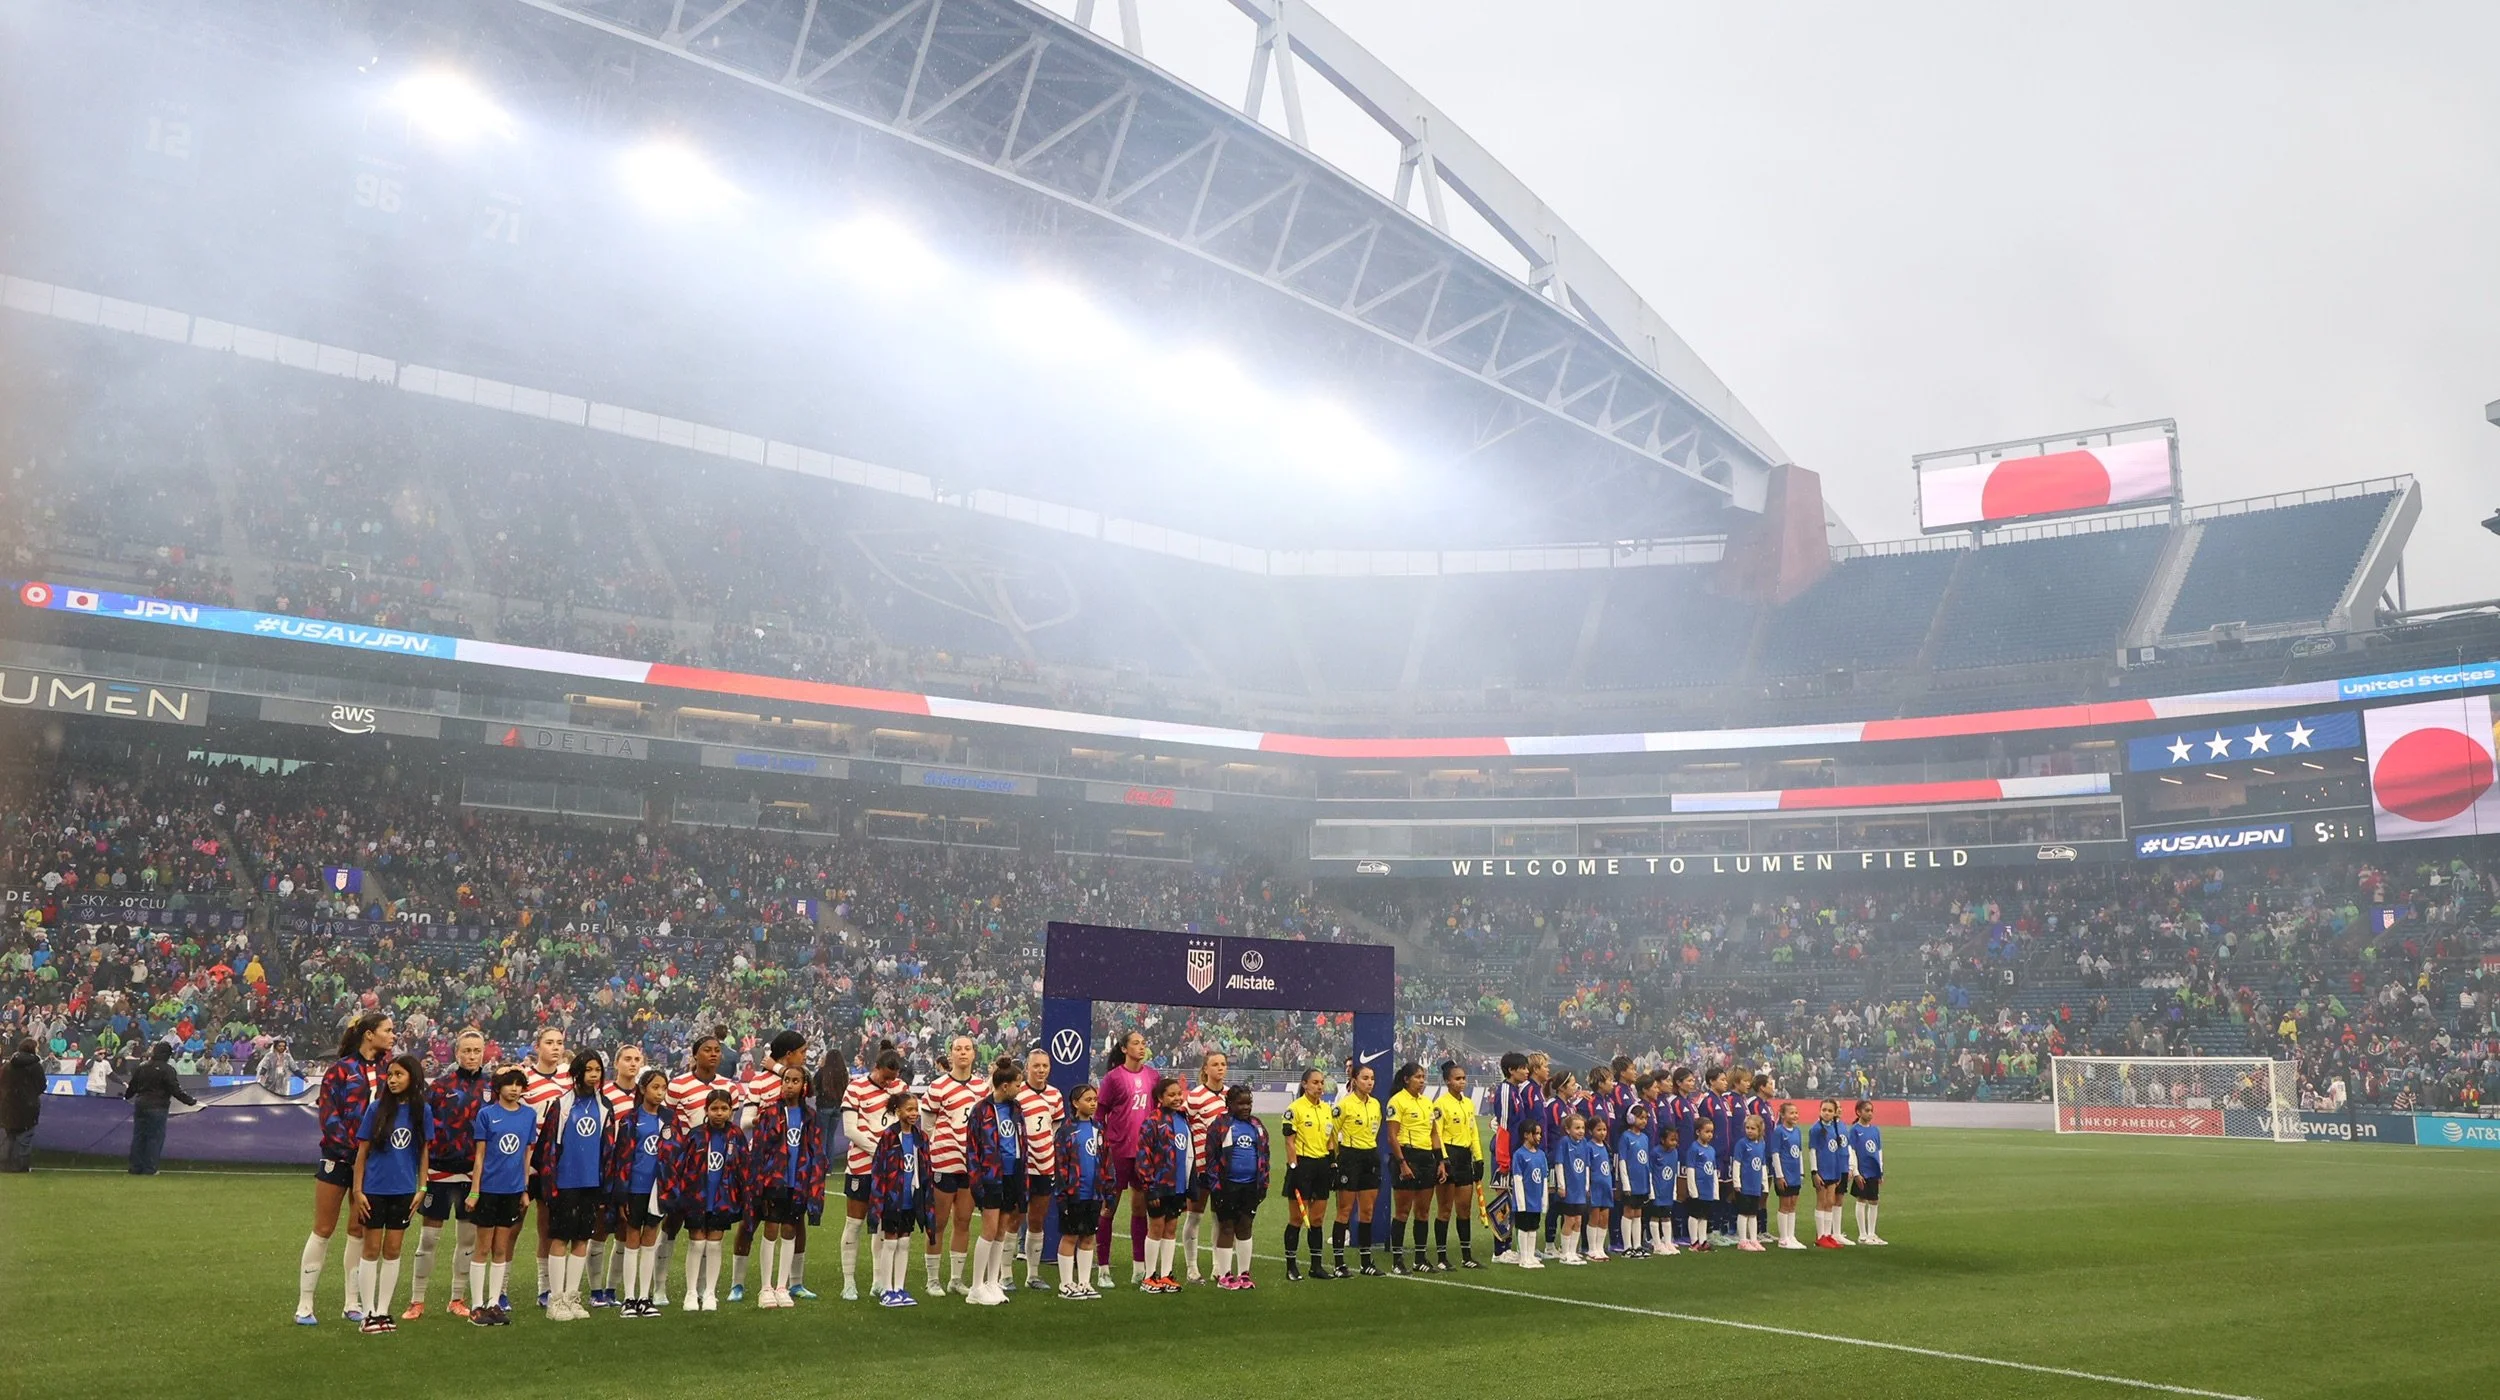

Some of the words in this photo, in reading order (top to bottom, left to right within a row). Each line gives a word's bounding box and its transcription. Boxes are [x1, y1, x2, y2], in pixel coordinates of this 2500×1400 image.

[353, 172, 403, 213] 96
[482, 205, 521, 246] 71
[123, 599, 199, 622] JPN
[2343, 677, 2414, 695] United
[2417, 668, 2496, 686] States
[331, 704, 376, 723] aws
[537, 730, 633, 755] DELTA
[1452, 859, 1620, 877] WELCOME
[1646, 857, 1686, 874] TO
[1713, 852, 1833, 874] LUMEN
[1862, 849, 1969, 870] FIELD
[139, 896, 166, 909] CLU
[1189, 951, 1212, 969] USA
[1225, 974, 1277, 991] Allstate
[1412, 1015, 1466, 1027] LUMEN
[1132, 1094, 1147, 1110] 24
[881, 1109, 888, 1127] 6
[962, 1107, 970, 1124] 5
[1036, 1116, 1044, 1132] 3
[2103, 1117, 2118, 1127] OF
[2121, 1118, 2176, 1129] AMERICA
